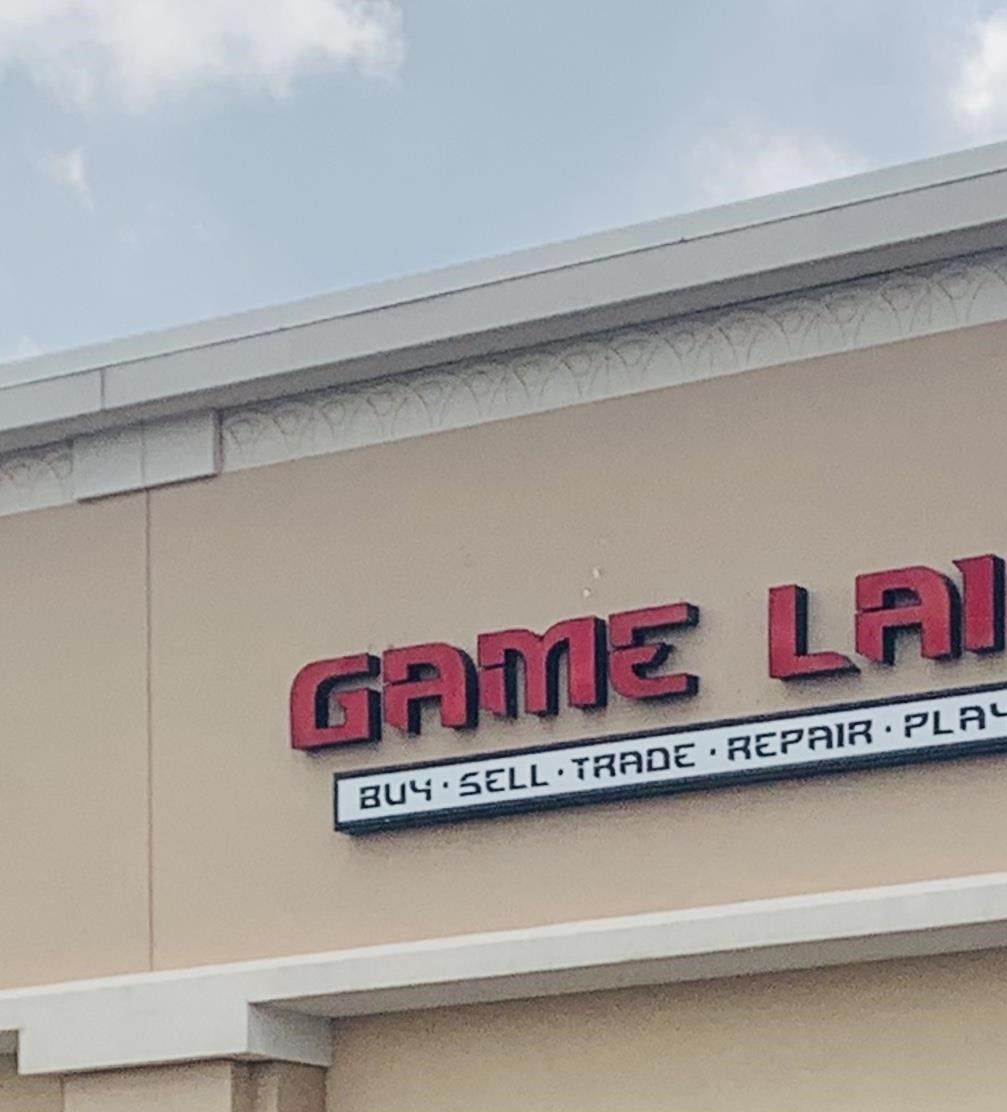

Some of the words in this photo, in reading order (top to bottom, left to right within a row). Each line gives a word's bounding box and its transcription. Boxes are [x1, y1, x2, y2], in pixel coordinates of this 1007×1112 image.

[290, 602, 698, 751] GAME
[359, 778, 432, 810] BUY
[459, 764, 549, 797] SELL
[571, 743, 696, 781] TRADE
[727, 719, 874, 762] REPAIR
